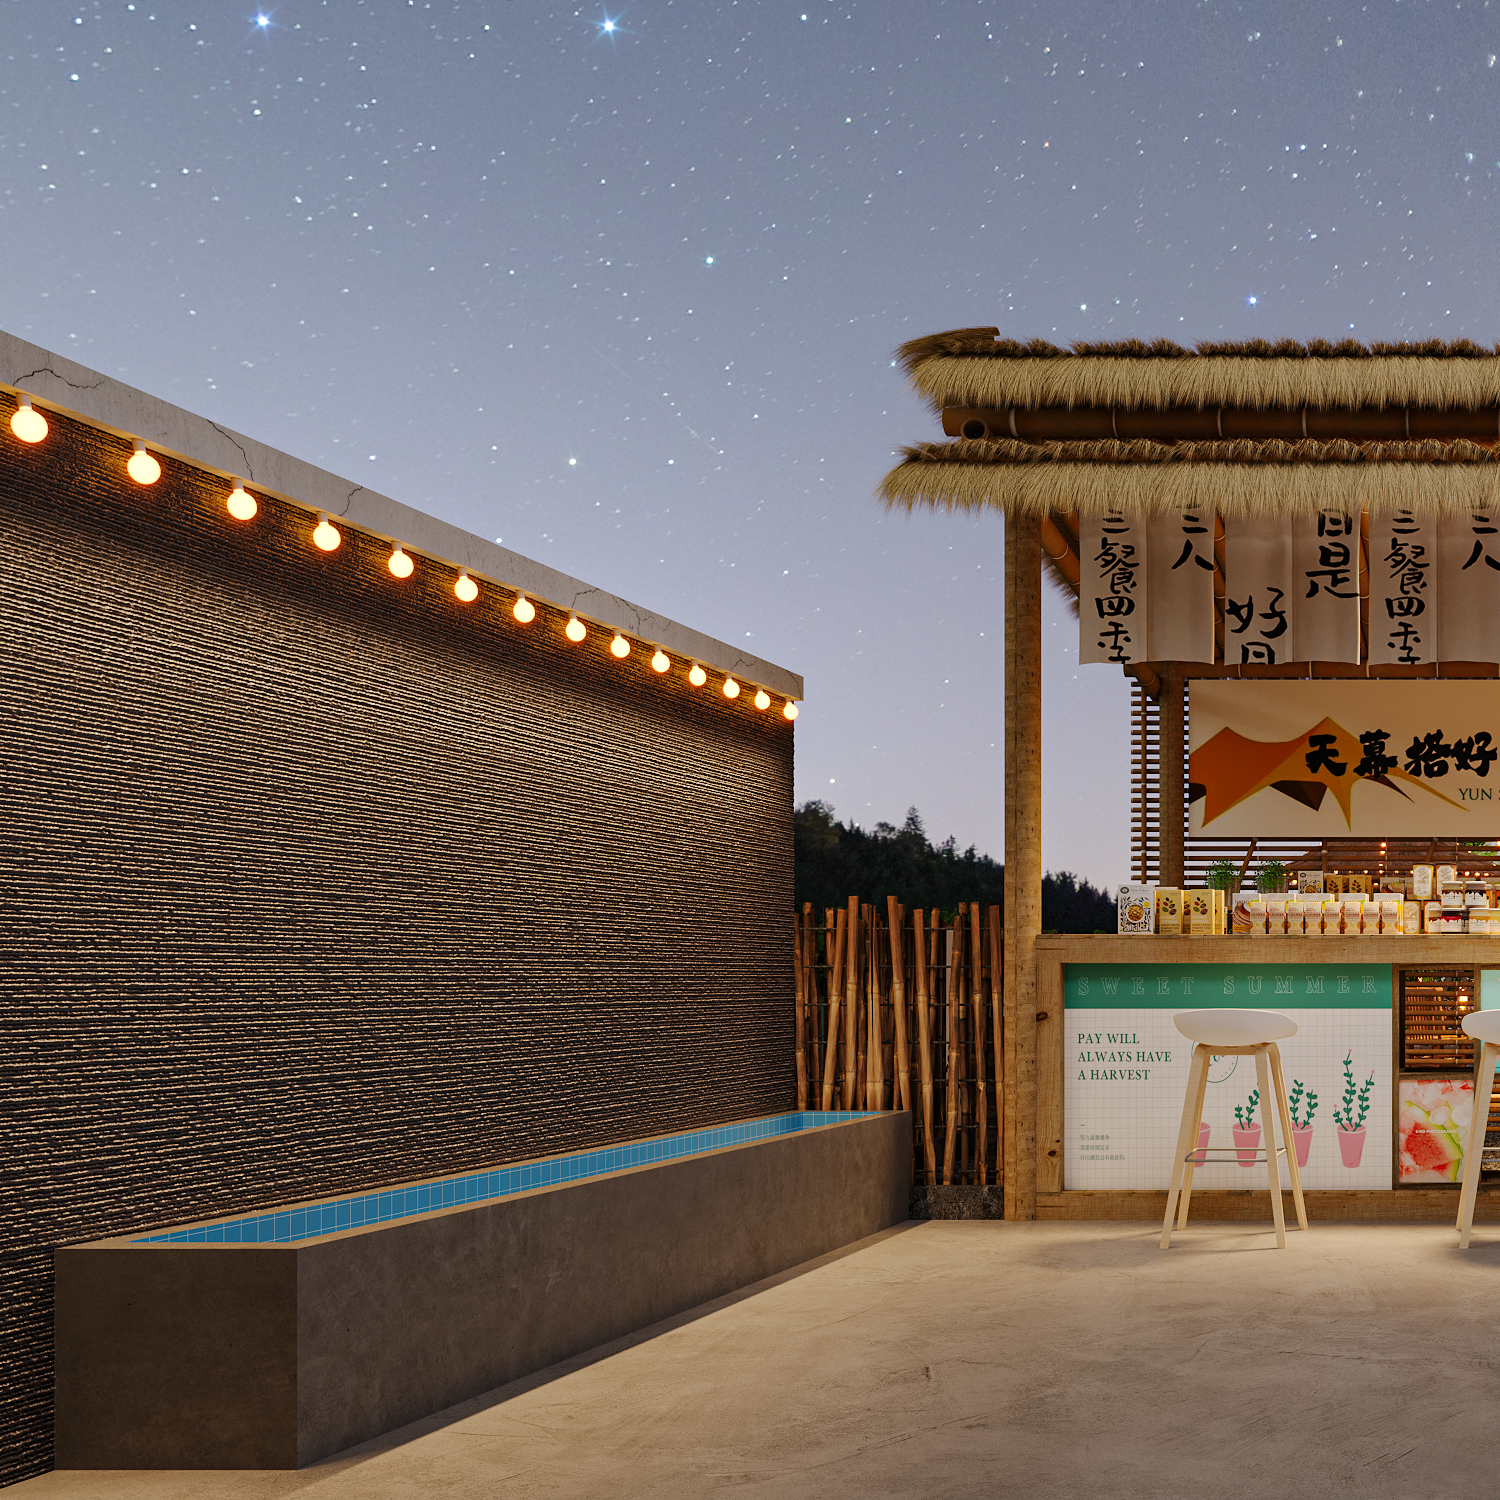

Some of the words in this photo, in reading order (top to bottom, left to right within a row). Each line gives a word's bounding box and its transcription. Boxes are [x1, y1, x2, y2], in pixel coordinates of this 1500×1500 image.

[1305, 729, 1498, 779] 天幕搭好
[1458, 788, 1493, 801] YUN
[1078, 976, 1194, 996] SWEET
[1223, 975, 1377, 995] SUMMER
[1077, 1033, 1102, 1044] PAY
[1106, 1033, 1140, 1044] WILL
[1077, 1051, 1134, 1063] ALWAYS
[1136, 1051, 1172, 1063] HAVE
[1077, 1069, 1087, 1080] A
[1092, 1069, 1151, 1081] HARVEST
